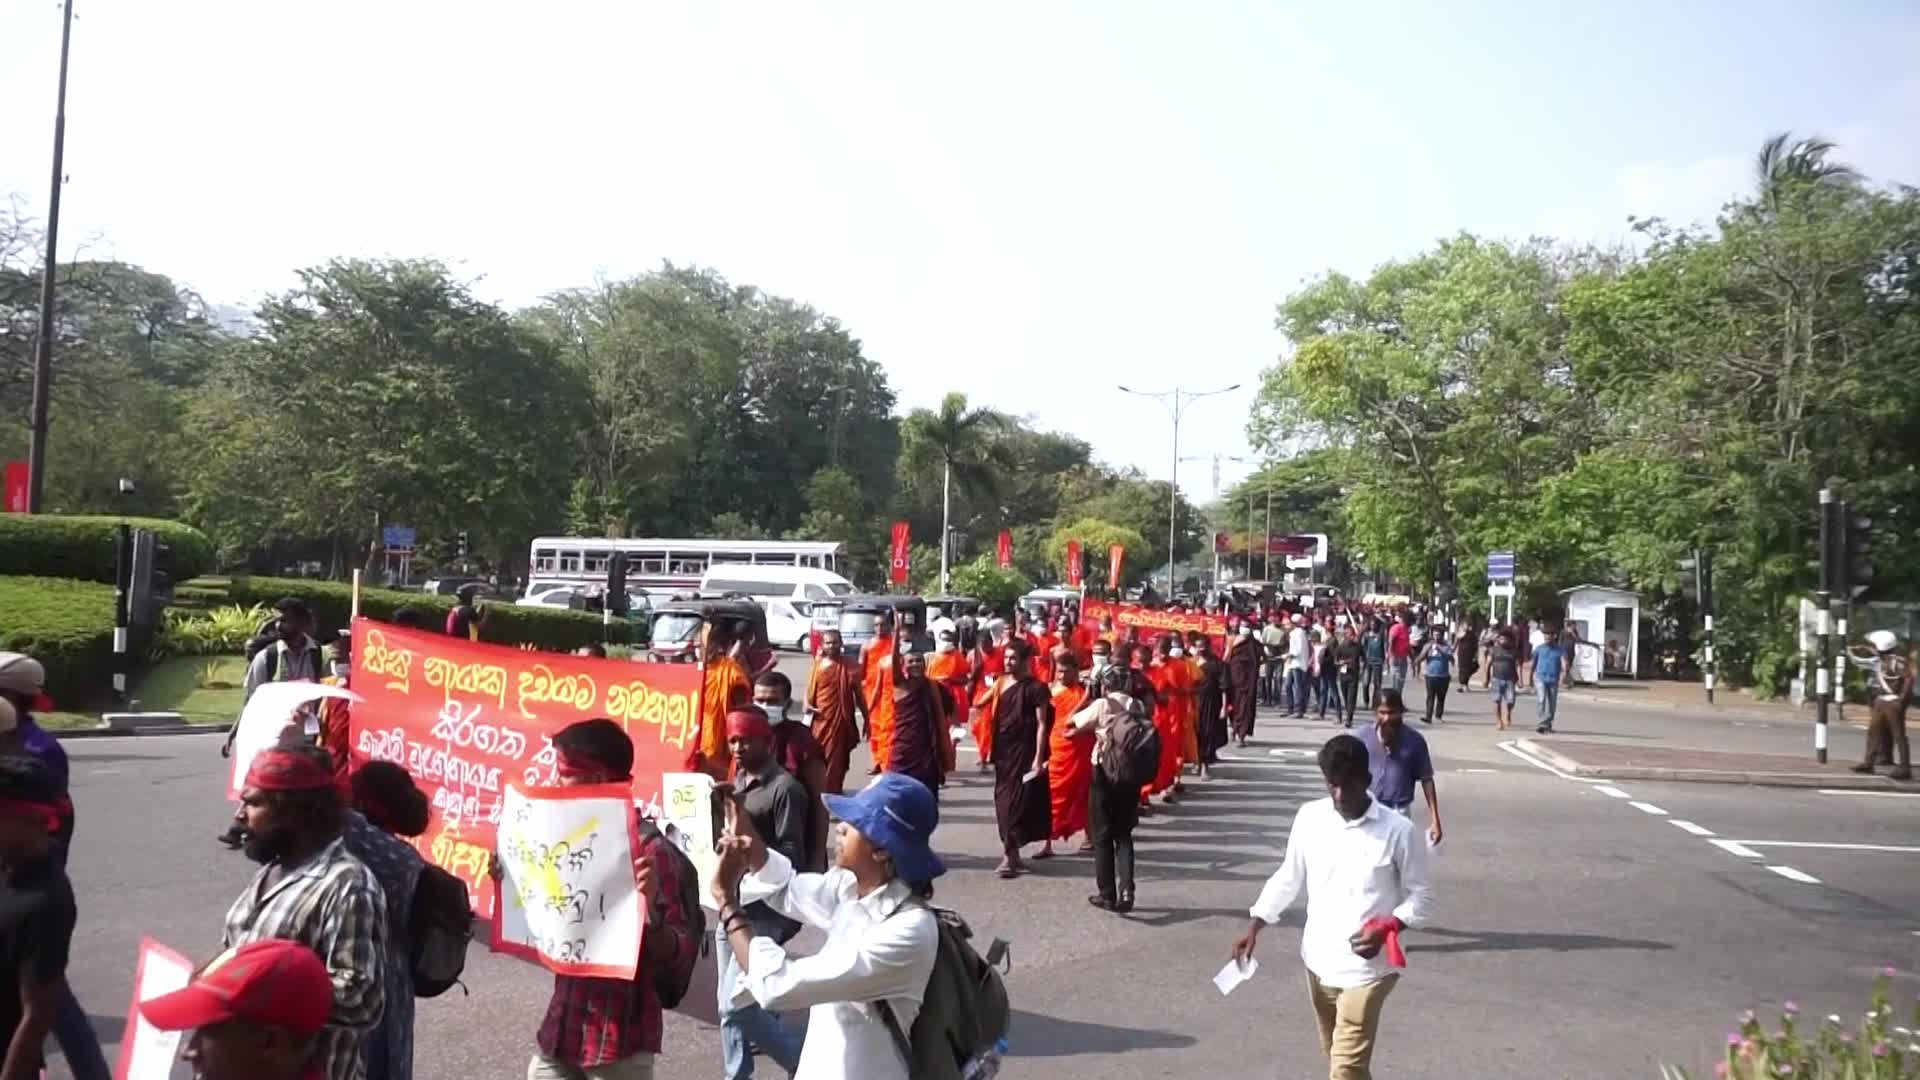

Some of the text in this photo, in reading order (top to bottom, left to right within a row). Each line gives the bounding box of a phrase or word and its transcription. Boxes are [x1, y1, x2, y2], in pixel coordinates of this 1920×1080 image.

[424, 657, 507, 710] නායක
[518, 664, 596, 719] දඩයම
[431, 700, 526, 759] සිරගත
